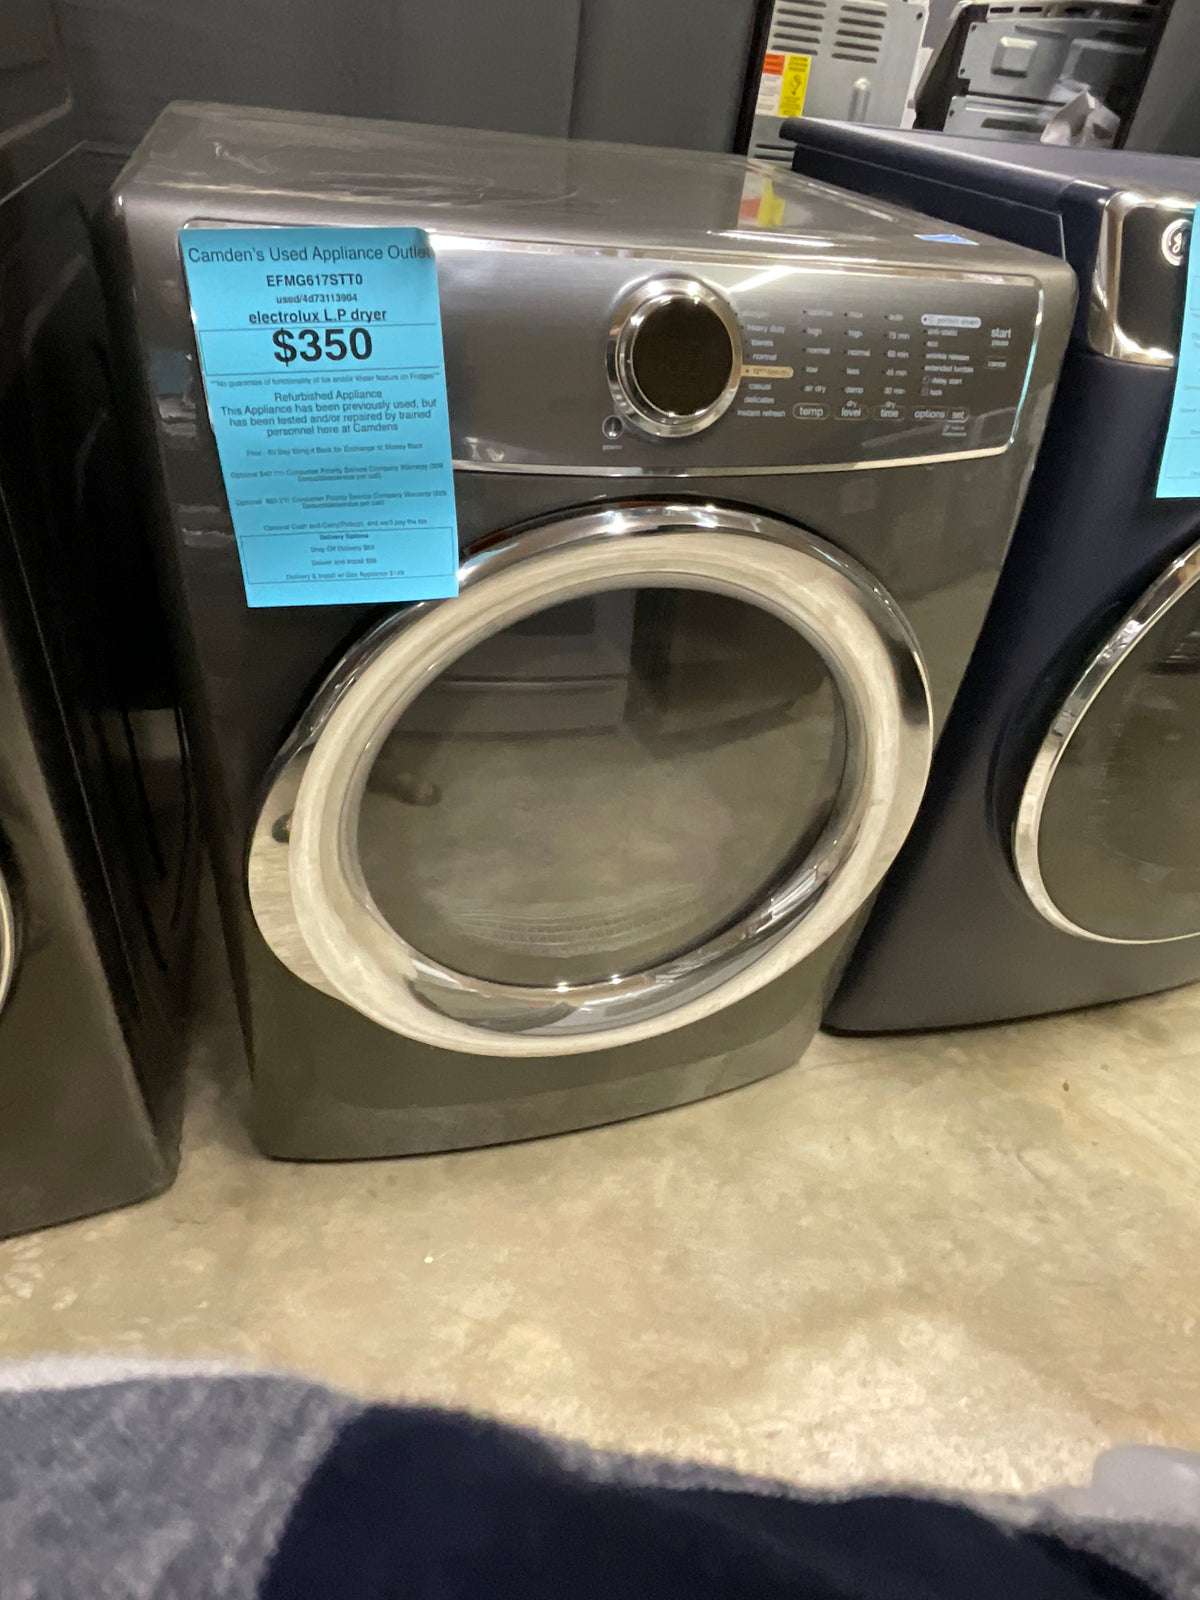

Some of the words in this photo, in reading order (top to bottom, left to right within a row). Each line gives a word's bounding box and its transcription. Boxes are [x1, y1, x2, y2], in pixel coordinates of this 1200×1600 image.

[188, 247, 265, 262] Camden's
[269, 246, 307, 261] Used
[313, 245, 383, 263] Appliance
[388, 244, 431, 260] Outlet
[266, 273, 363, 287] EFMG617STT0
[249, 310, 320, 323] electrolux
[324, 309, 346, 322] L.P
[351, 308, 387, 324] dryer
[991, 327, 1011, 339] start
[273, 327, 373, 367] $350
[807, 347, 831, 355] normal
[847, 349, 870, 357] normal
[752, 353, 777, 361] normal
[275, 391, 333, 402] Refurbished
[336, 390, 382, 402] Appliance
[221, 405, 242, 416] This
[245, 404, 292, 417] Appliance
[295, 403, 312, 413] has
[316, 402, 340, 412] been
[343, 400, 390, 413] previously
[422, 398, 437, 408] but
[799, 407, 824, 419] temp
[841, 406, 861, 417] level
[880, 408, 899, 418] time
[229, 417, 247, 427] has
[250, 417, 275, 426] been
[278, 414, 307, 425] tested
[310, 413, 340, 424] and/or
[344, 411, 383, 423] repaired
[385, 410, 396, 422] by
[399, 409, 431, 420] trained
[914, 409, 946, 420] options
[952, 410, 965, 419] set
[267, 425, 314, 438] personnel
[318, 424, 339, 434] here
[342, 423, 350, 433] at
[353, 421, 399, 433] Camdens
